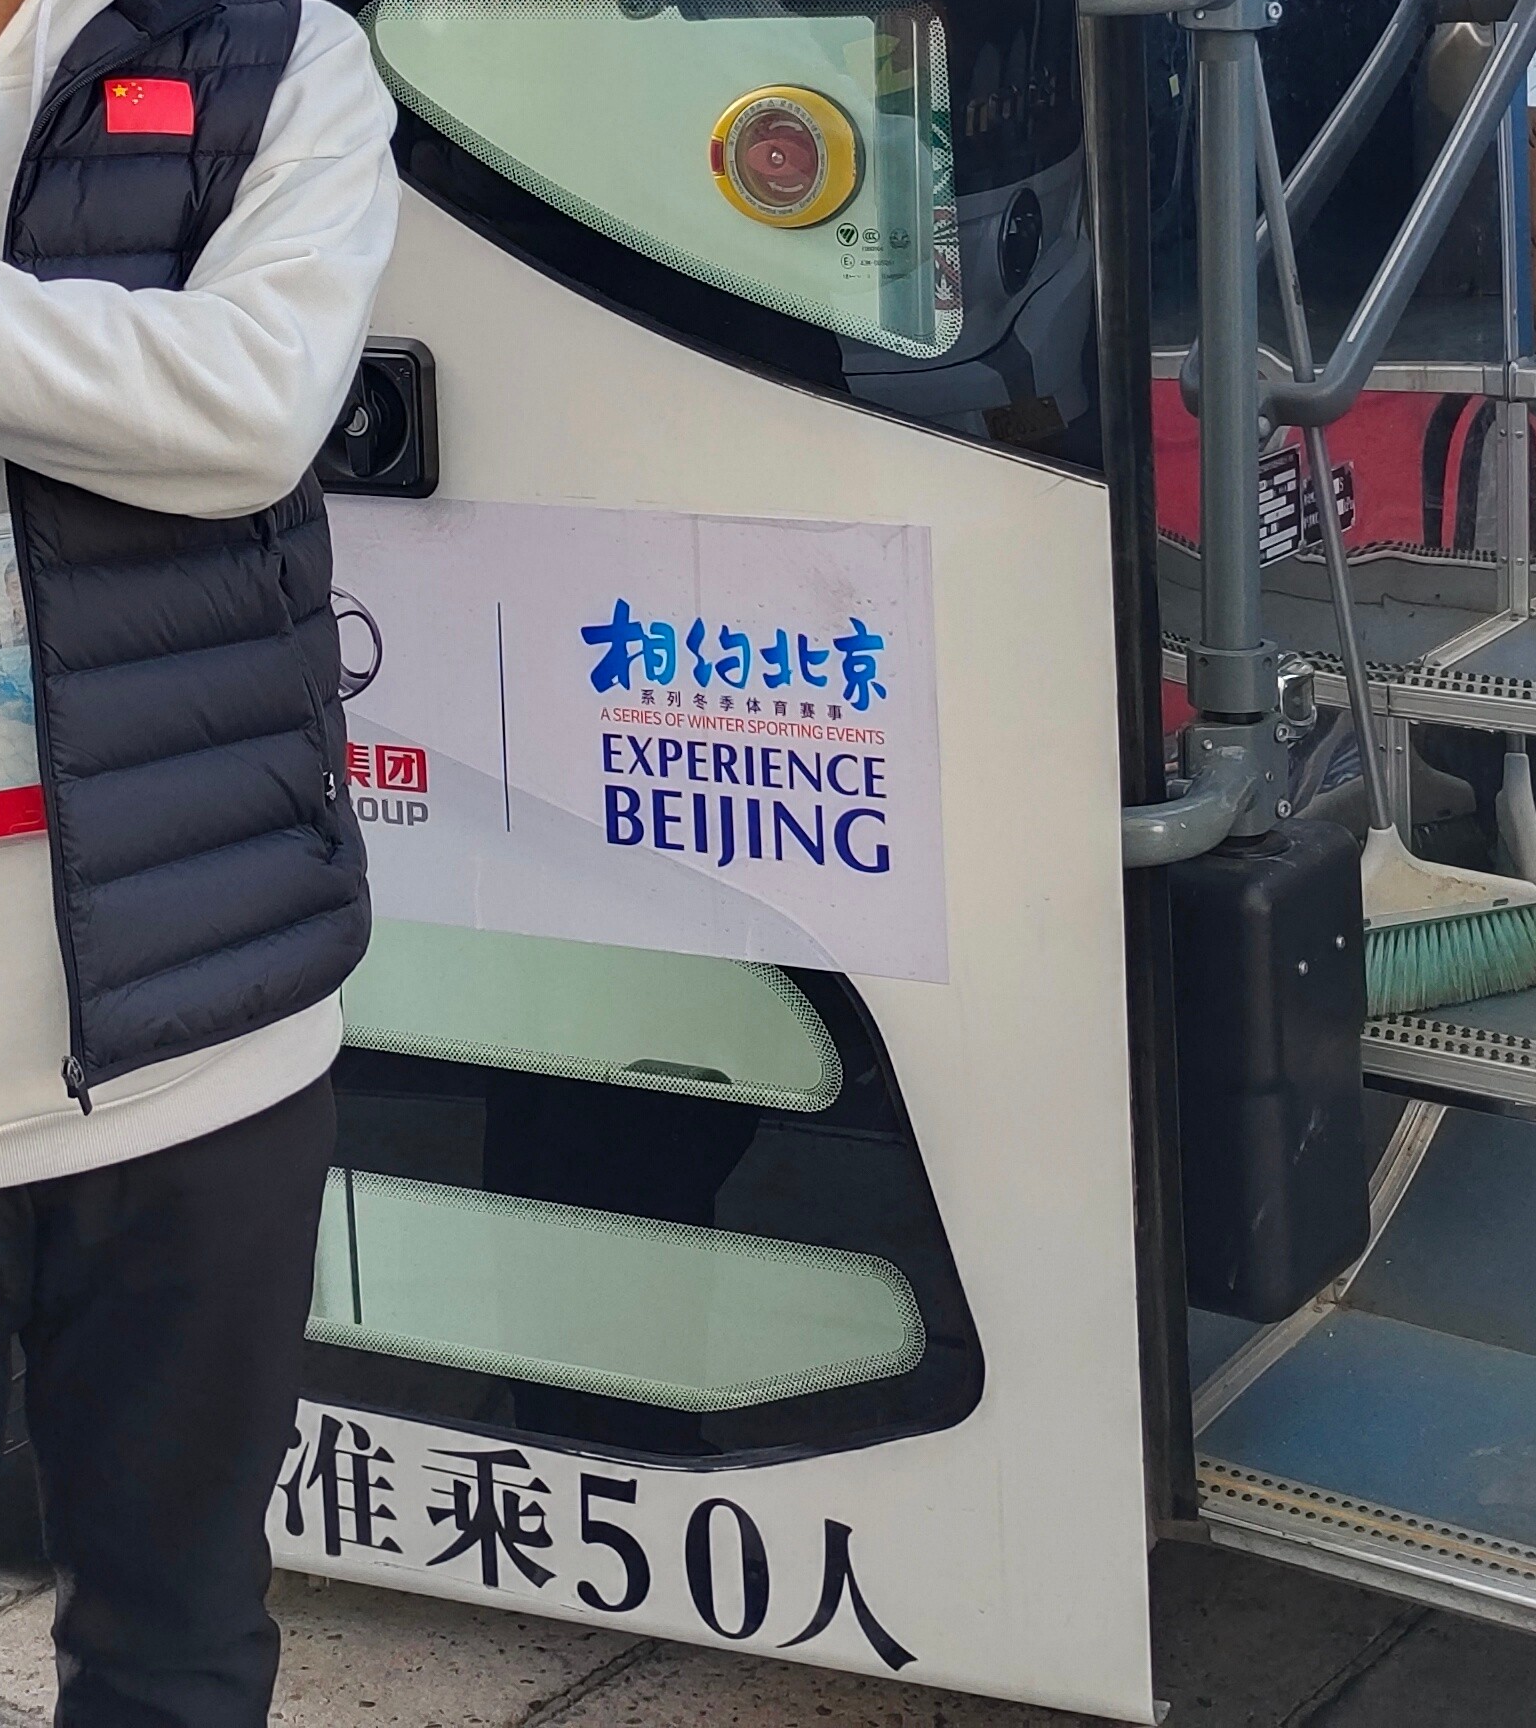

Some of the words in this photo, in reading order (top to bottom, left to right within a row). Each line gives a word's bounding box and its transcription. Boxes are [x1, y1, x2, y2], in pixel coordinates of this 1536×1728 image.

[580, 598, 888, 712] 相约北京
[600, 706, 612, 722] A
[613, 709, 662, 726] SERIES
[665, 713, 684, 728] OF
[687, 715, 746, 734] WINTER
[747, 720, 824, 741] SPORTING
[826, 728, 886, 746] EVENTS
[641, 689, 843, 721] 系列冬季体育赛事
[601, 732, 888, 800] EXPERIENCE
[603, 784, 891, 875] BEIJING
